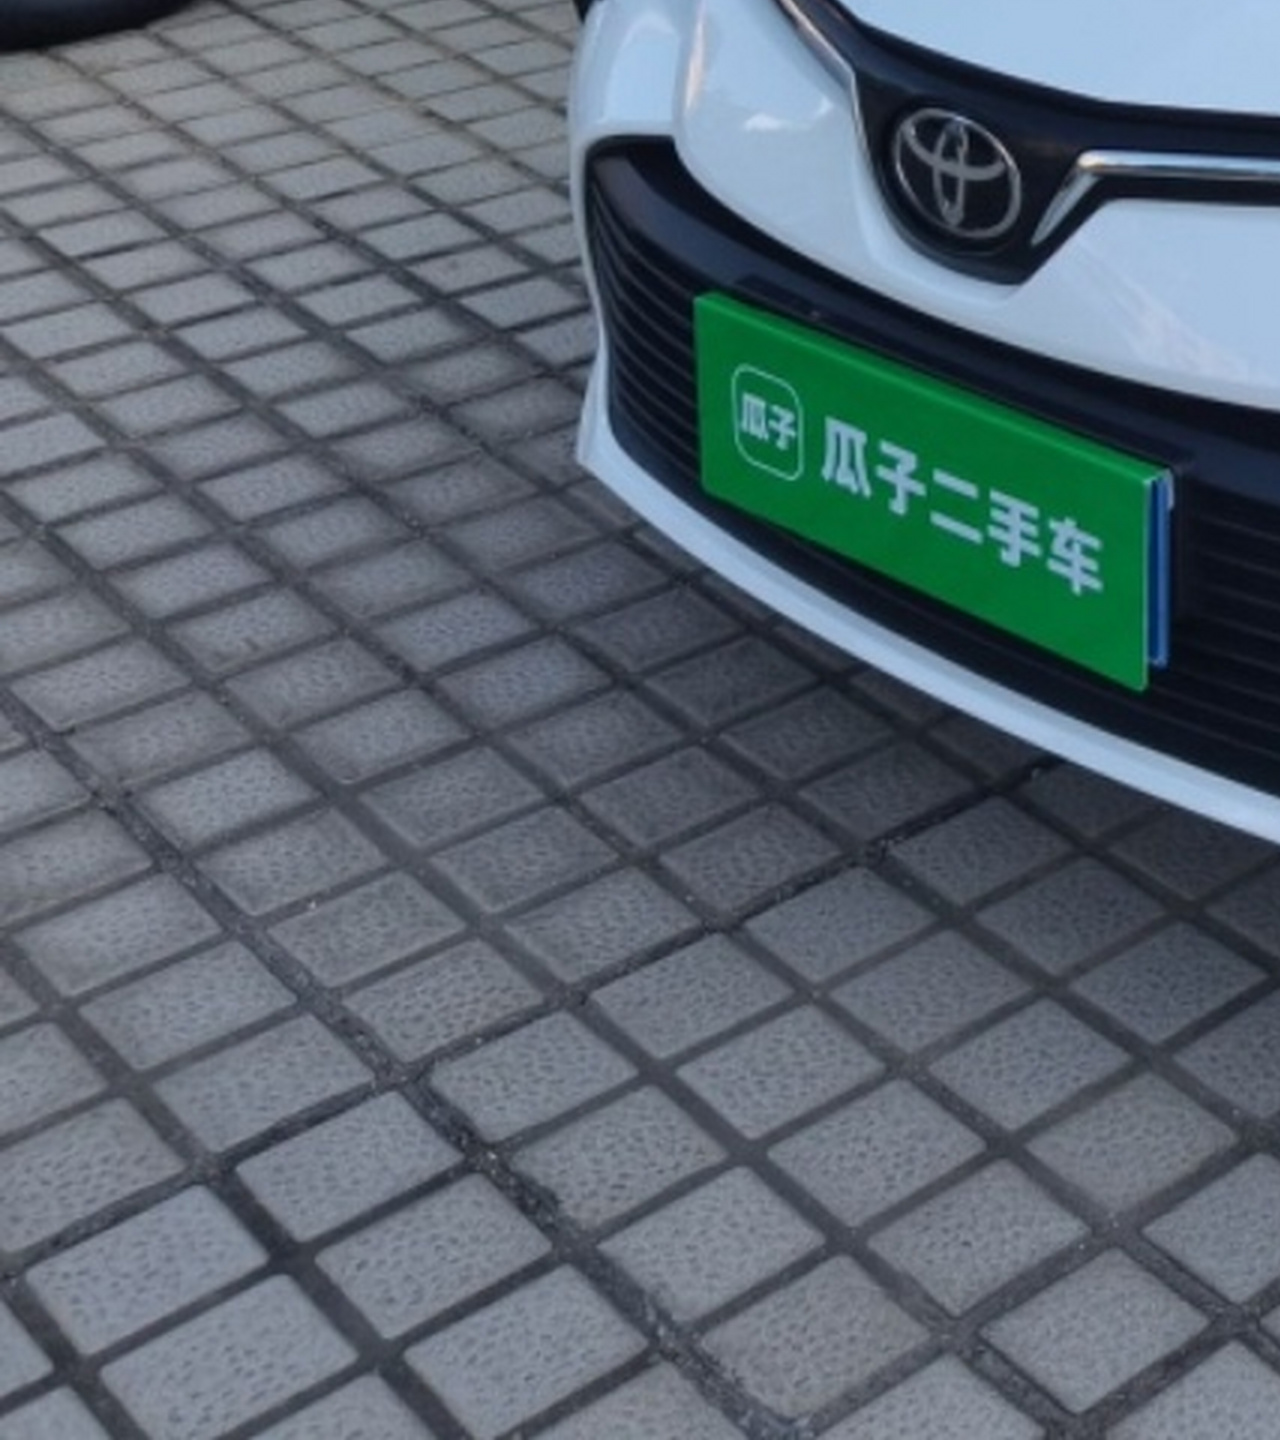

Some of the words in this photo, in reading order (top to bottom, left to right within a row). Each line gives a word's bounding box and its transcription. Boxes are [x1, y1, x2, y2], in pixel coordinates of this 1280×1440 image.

[741, 392, 797, 451] 瓜子
[821, 415, 1103, 596] 瓜子二手车
